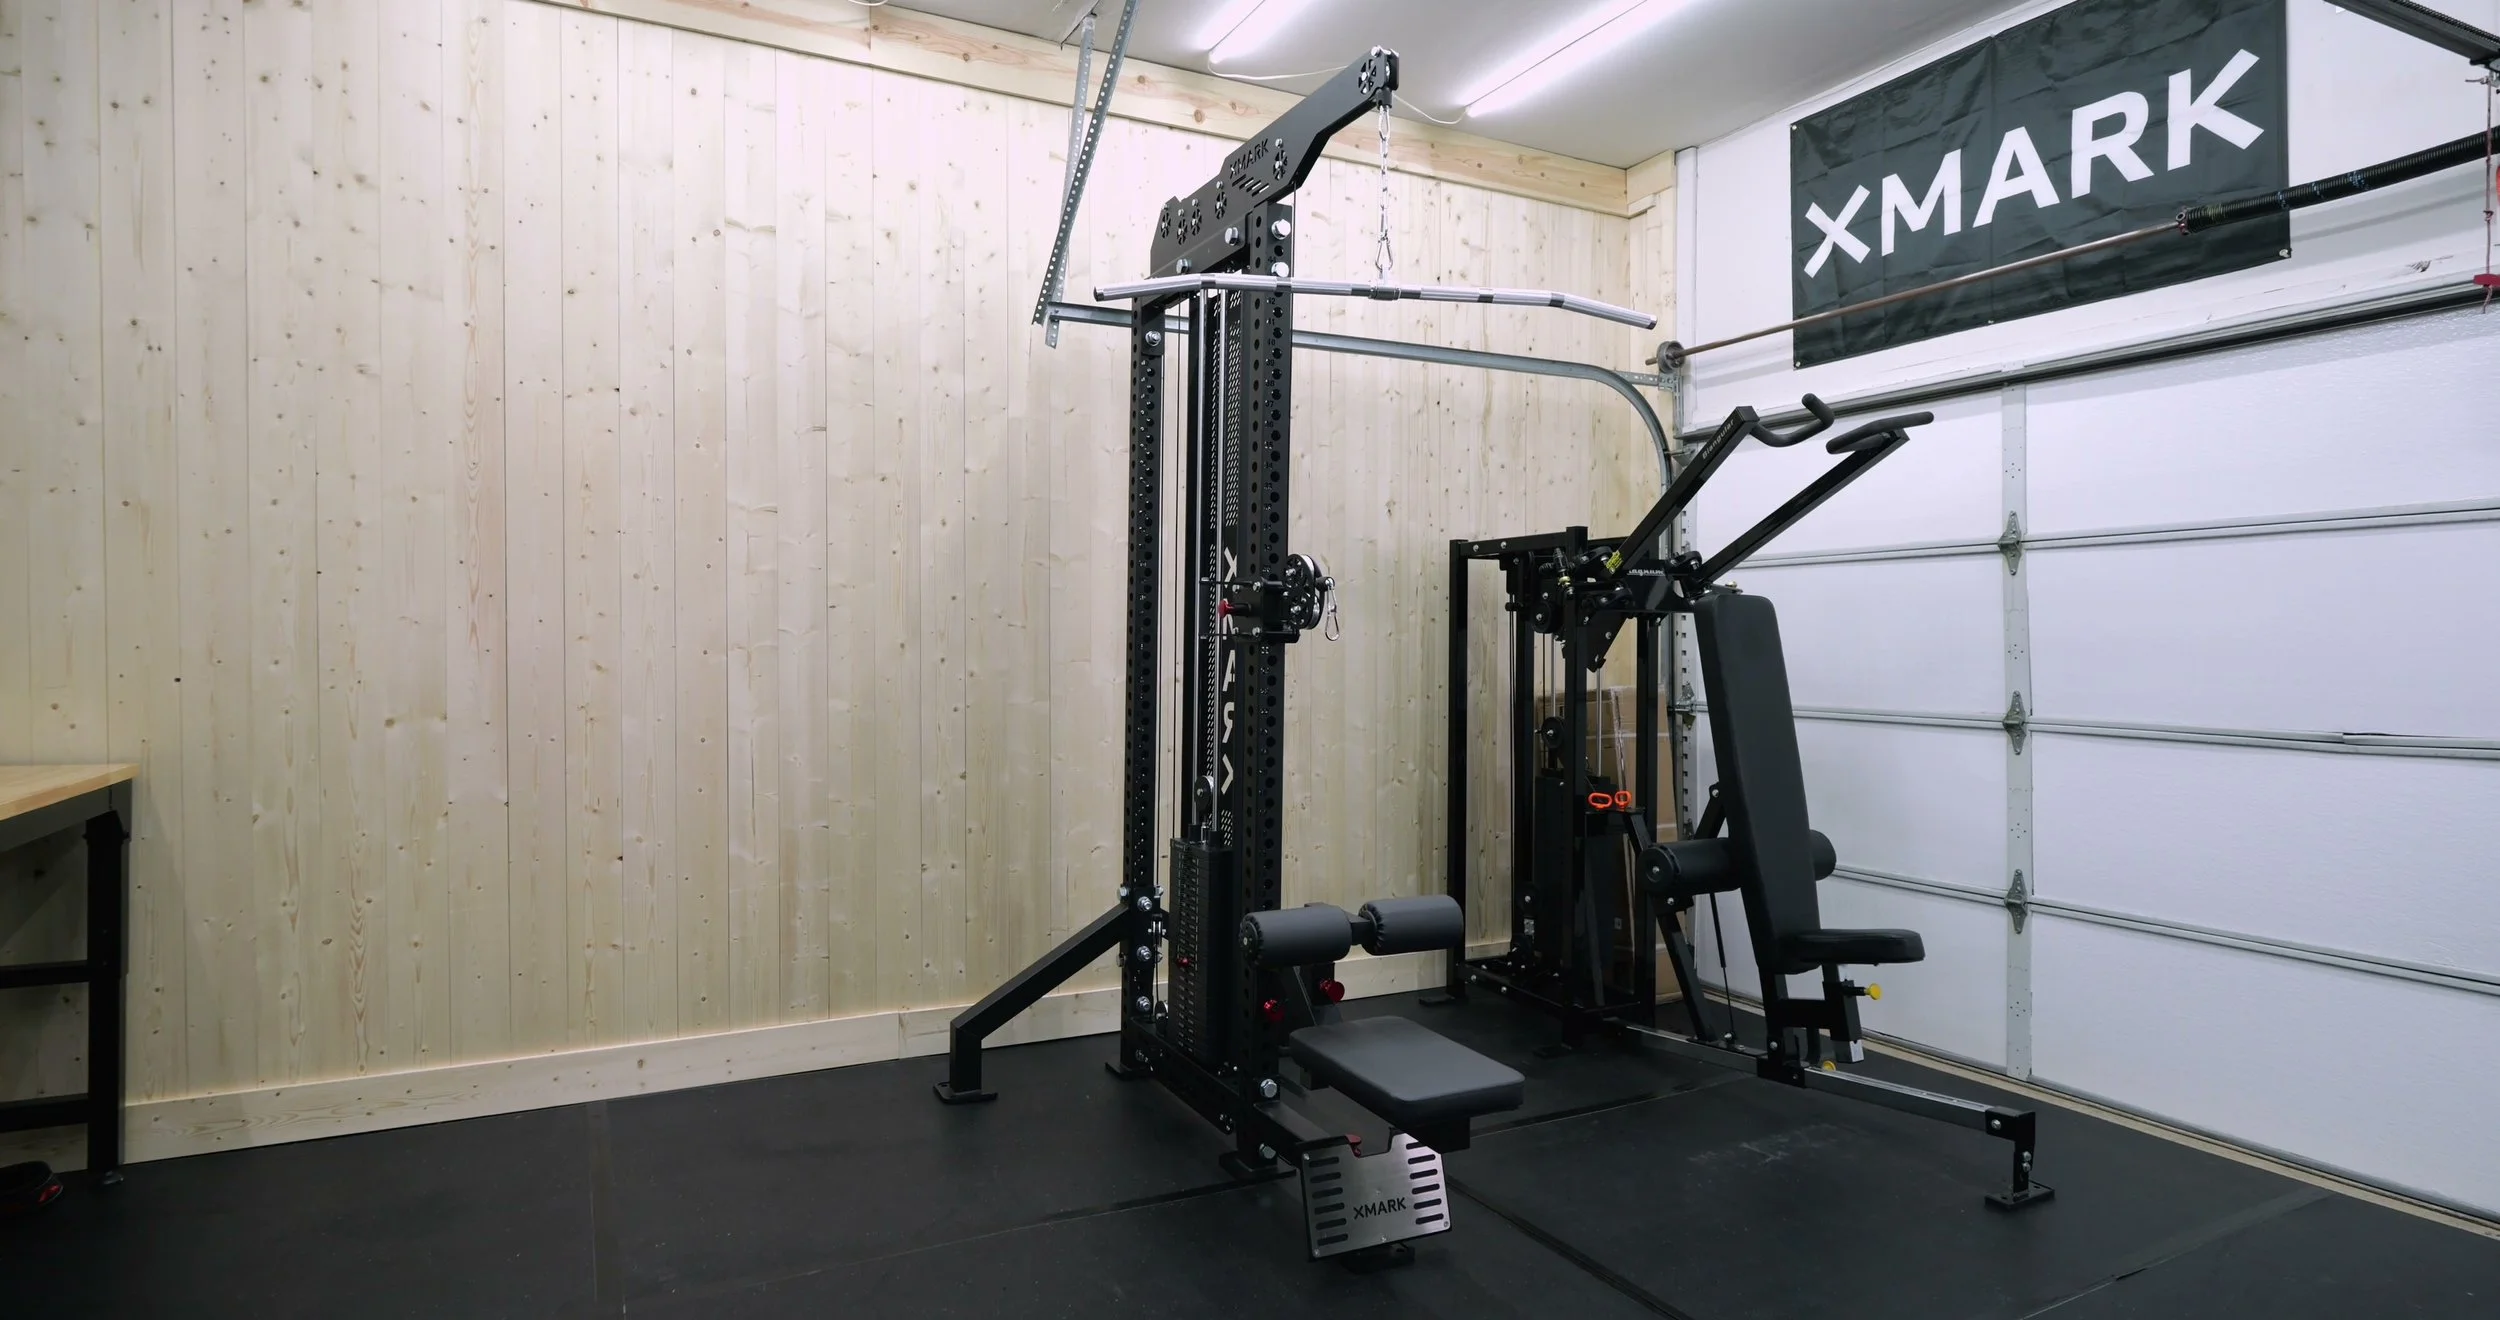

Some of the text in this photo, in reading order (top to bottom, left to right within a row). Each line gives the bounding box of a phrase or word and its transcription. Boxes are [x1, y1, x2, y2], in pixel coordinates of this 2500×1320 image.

[1229, 138, 1269, 180] XMARK
[1804, 48, 2265, 278] XMARK
[1702, 418, 1734, 460] Biangular
[1353, 1197, 1407, 1220] XMARK
